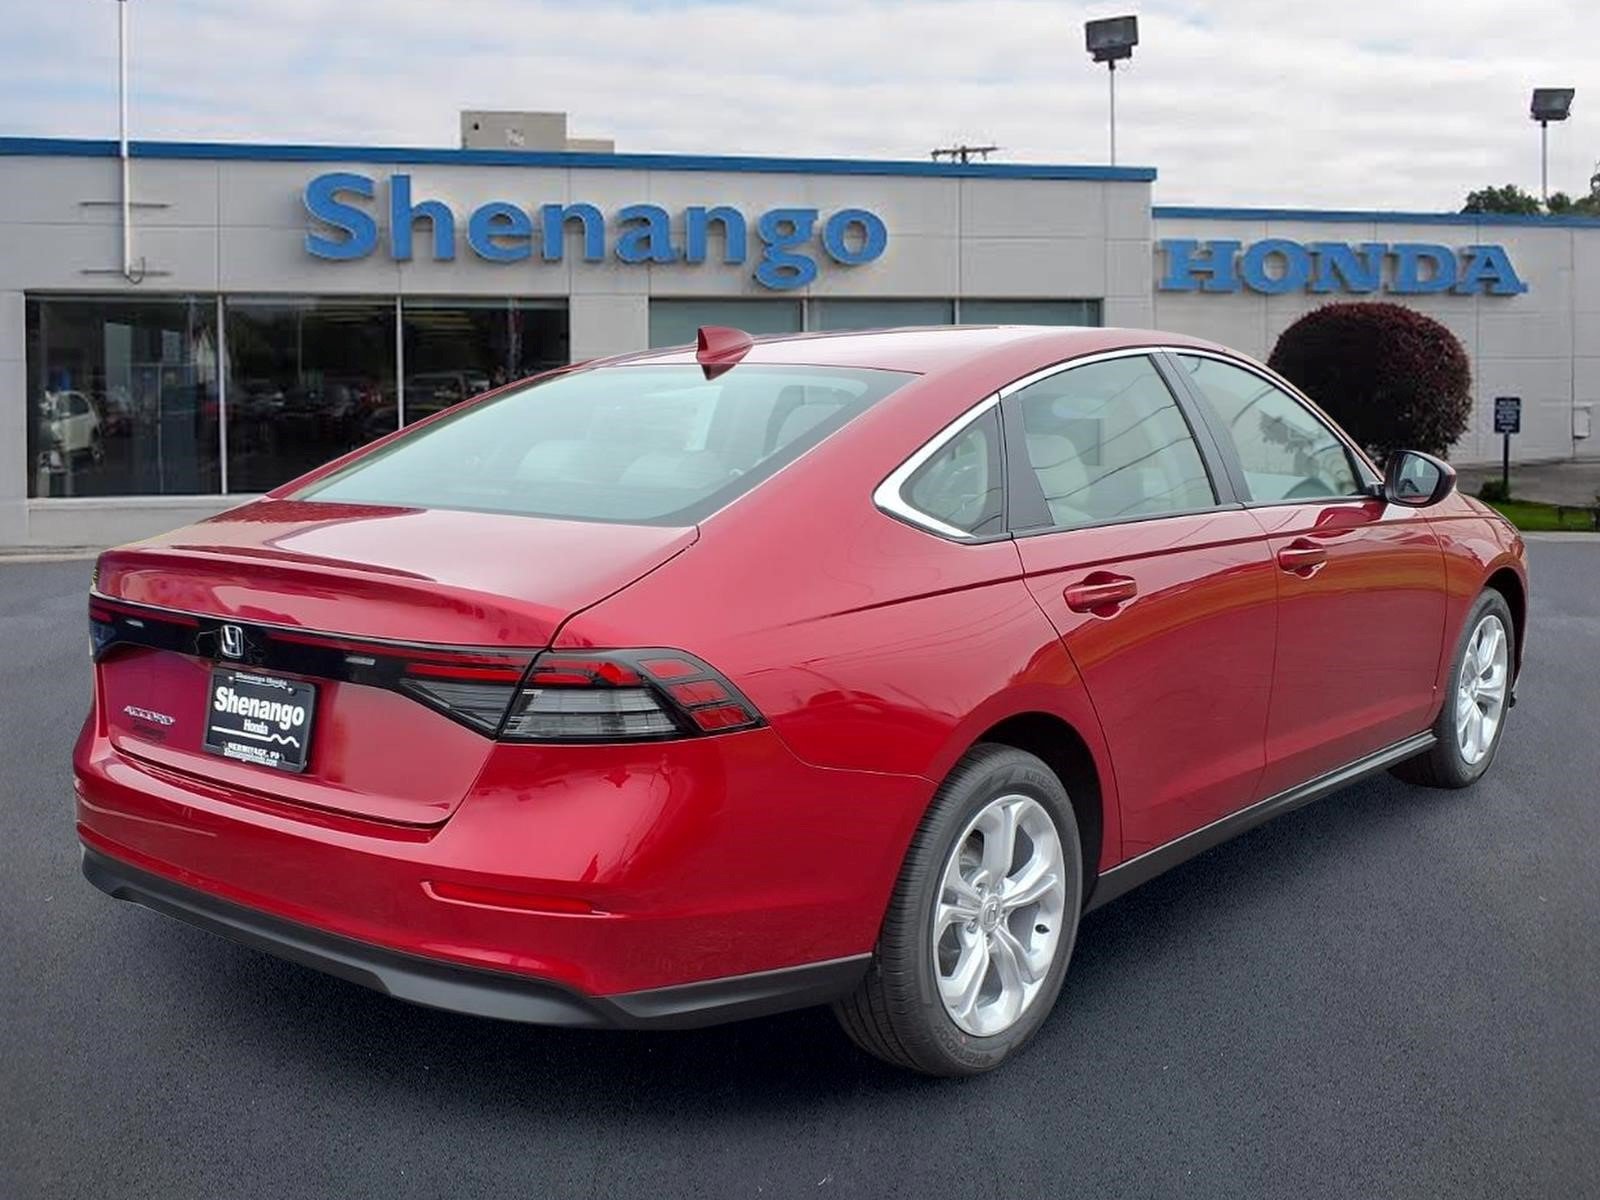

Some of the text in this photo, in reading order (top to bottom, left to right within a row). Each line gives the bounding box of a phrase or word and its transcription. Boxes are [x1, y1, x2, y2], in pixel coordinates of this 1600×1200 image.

[304, 172, 888, 291] Shenango
[1157, 238, 1528, 296] HONDA
[214, 686, 305, 730] Shenango
[243, 718, 269, 735] Honda
